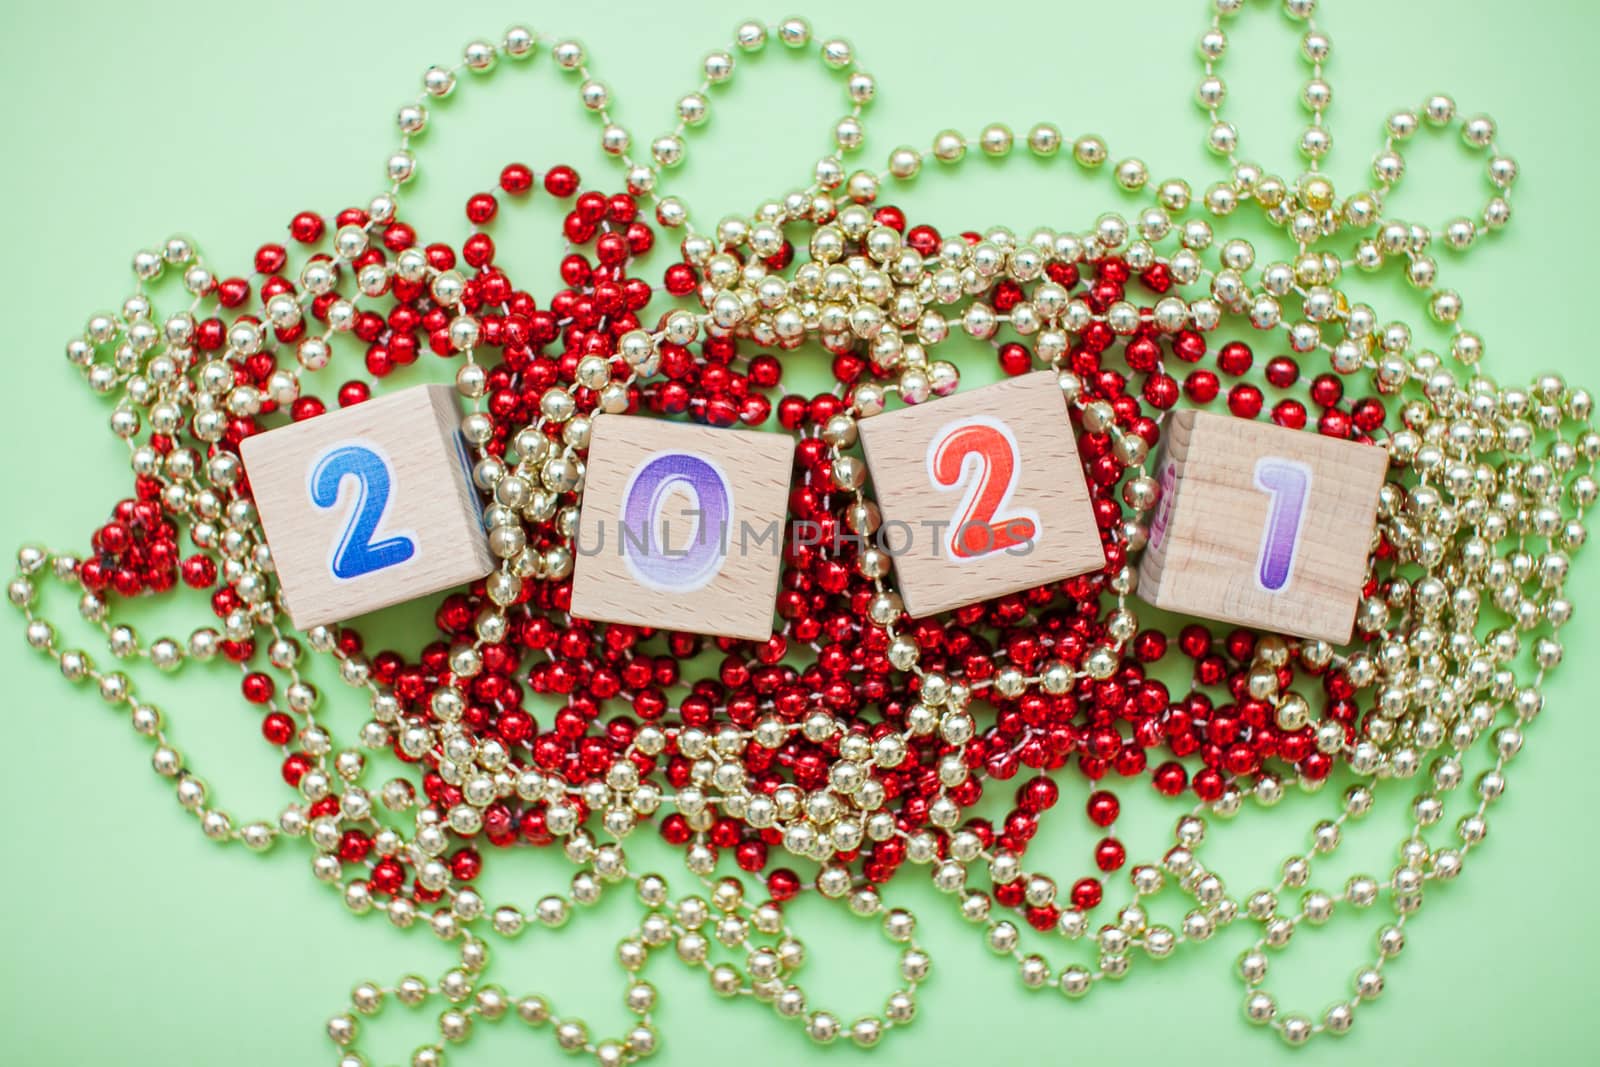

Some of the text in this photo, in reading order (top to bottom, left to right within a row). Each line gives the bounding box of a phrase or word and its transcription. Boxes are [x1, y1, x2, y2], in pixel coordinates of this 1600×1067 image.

[310, 446, 415, 579] 2
[626, 453, 729, 586] 0
[932, 425, 1036, 558] 2
[1257, 464, 1306, 590] 1
